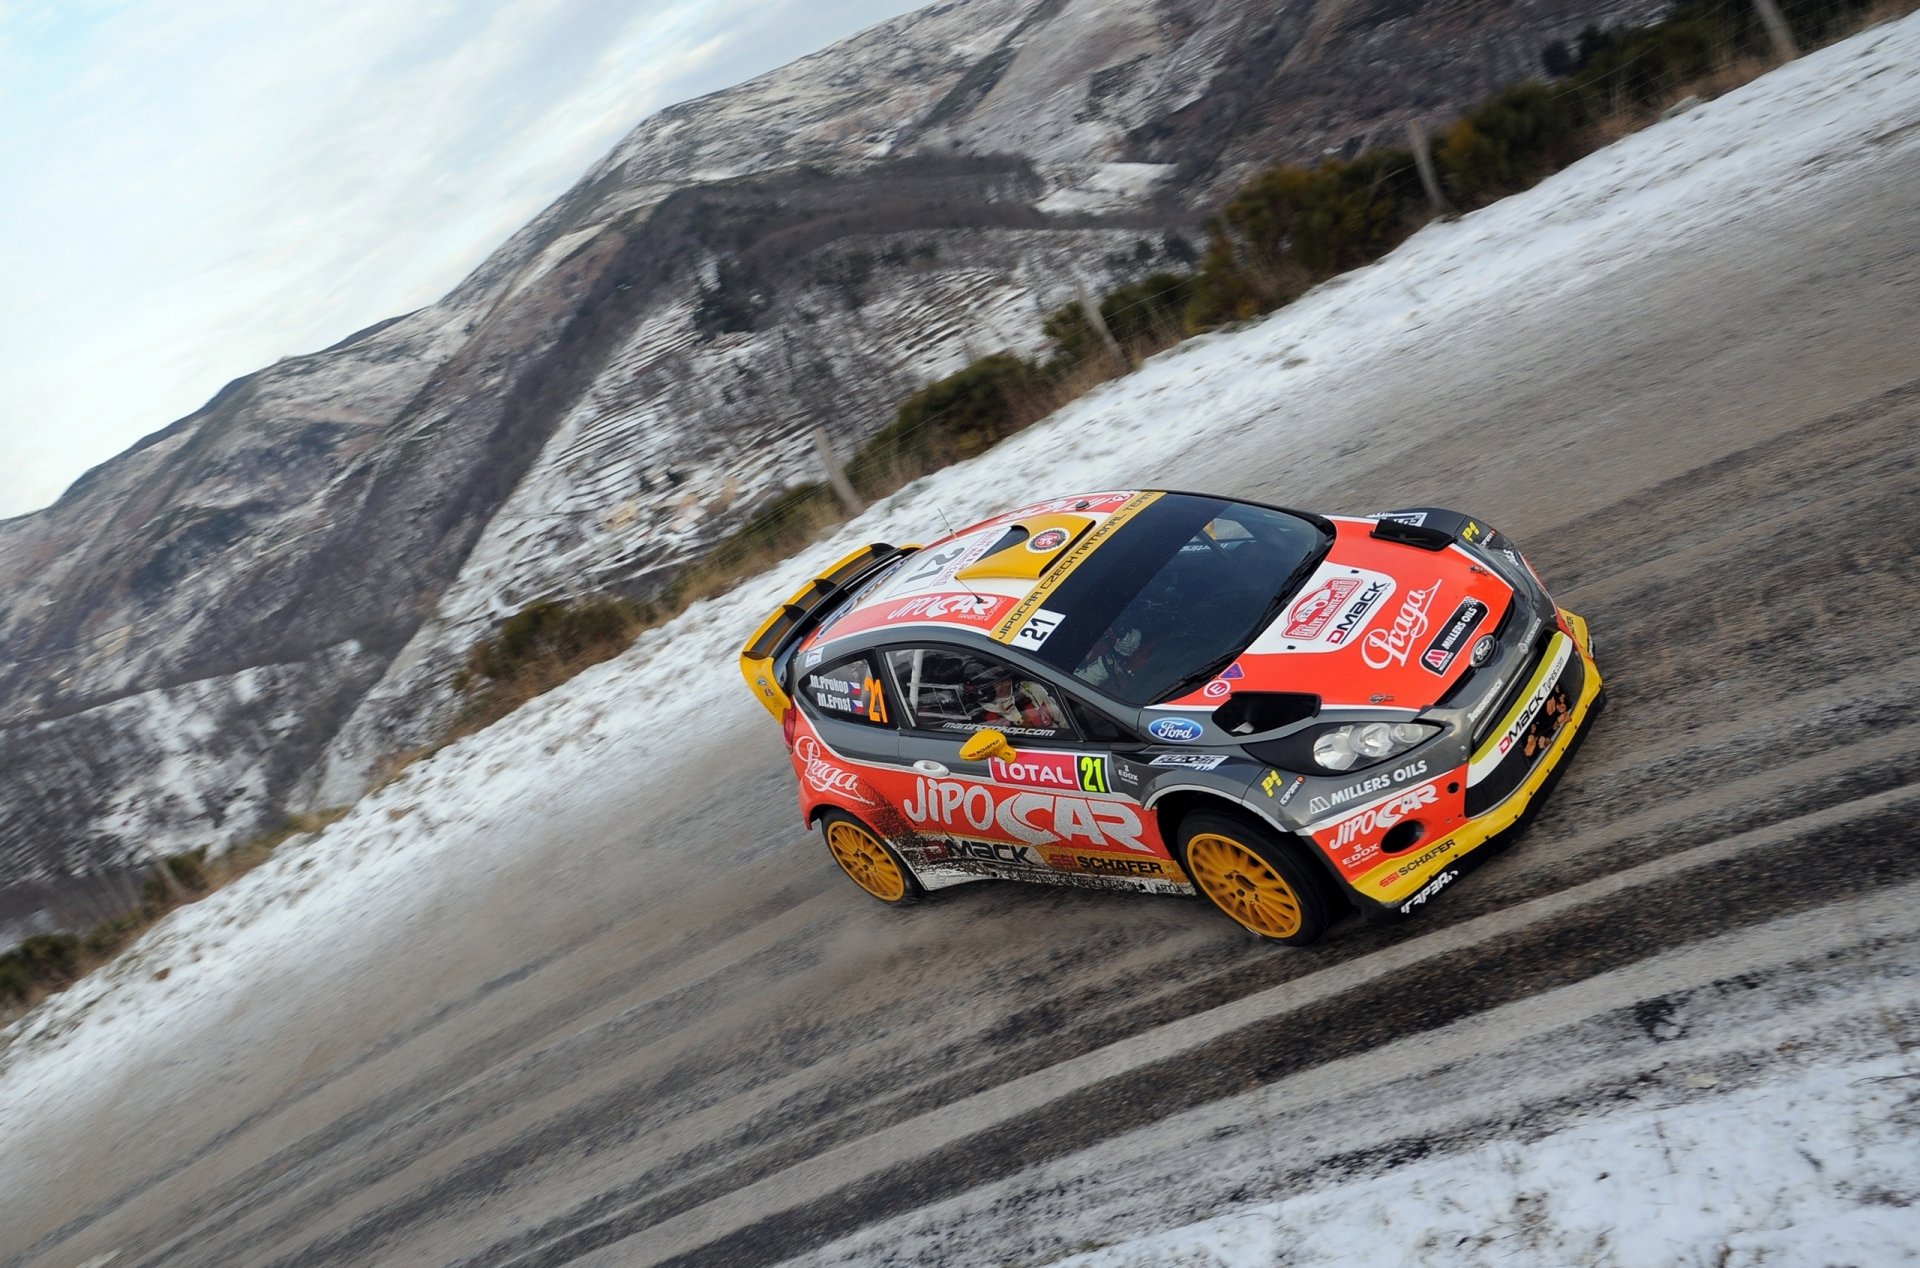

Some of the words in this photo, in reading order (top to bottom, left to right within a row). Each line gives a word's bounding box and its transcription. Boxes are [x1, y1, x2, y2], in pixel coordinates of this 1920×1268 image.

[999, 591, 1043, 640] JIPOCAR
[1040, 556, 1079, 590] CZECH
[1075, 513, 1127, 555] NATIONAL
[1020, 617, 1056, 642] 21
[1361, 579, 1443, 669] Praga
[1441, 621, 1467, 650] MILLERS
[1461, 607, 1478, 623] OILS
[810, 674, 849, 694] M.Prokop
[817, 692, 852, 712] M.Ernst
[864, 676, 889, 723] 21
[1157, 720, 1193, 739] Ford
[795, 735, 875, 806] Praga
[994, 757, 1074, 785] TOTAL
[1081, 756, 1106, 793] 21
[1331, 774, 1390, 805] MILLERS
[1393, 760, 1428, 782] OILS
[1342, 843, 1380, 865] EDOX
